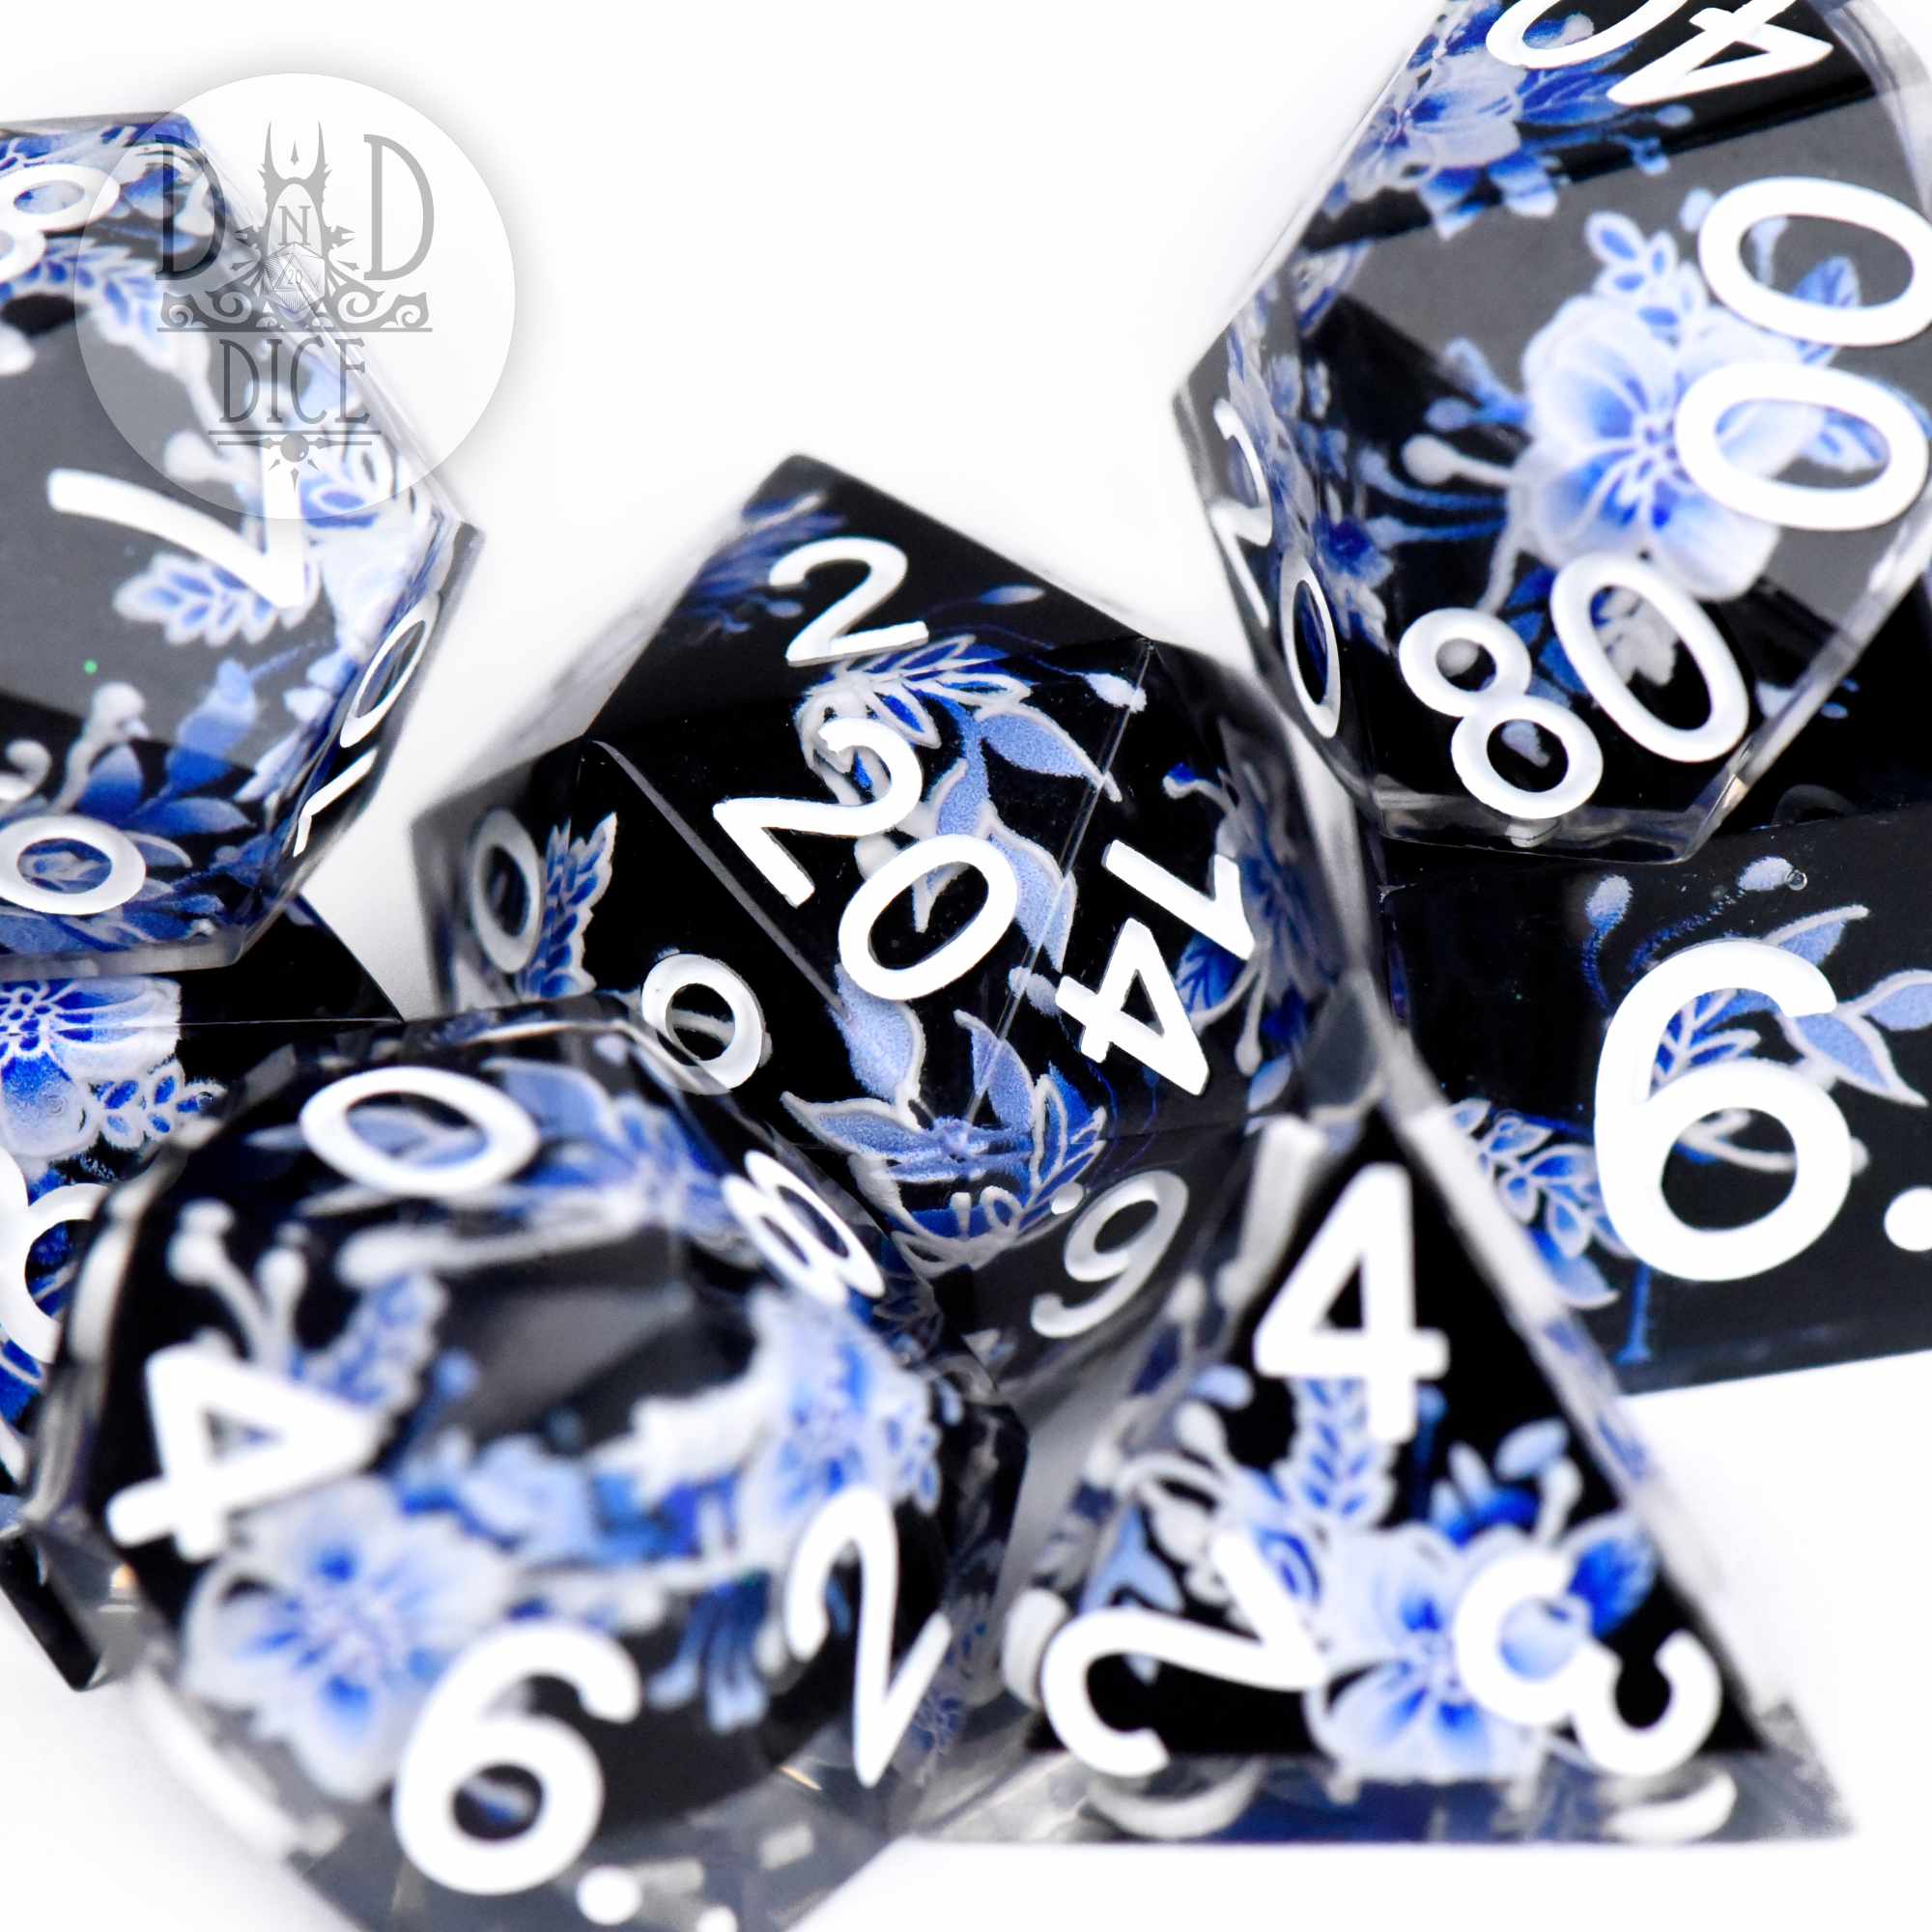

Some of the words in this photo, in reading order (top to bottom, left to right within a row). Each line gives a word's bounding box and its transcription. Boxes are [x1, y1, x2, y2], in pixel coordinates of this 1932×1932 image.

[769, 537, 928, 666] 2
[1399, 550, 1749, 819] 80
[713, 718, 1018, 1001] 20
[1055, 838, 1255, 1095] 14
[1255, 1163, 1449, 1444] 4
[106, 1343, 380, 1563] 4
[784, 1486, 952, 1788] 2
[1040, 1531, 1331, 1776] 2
[1452, 1549, 1721, 1776] 3
